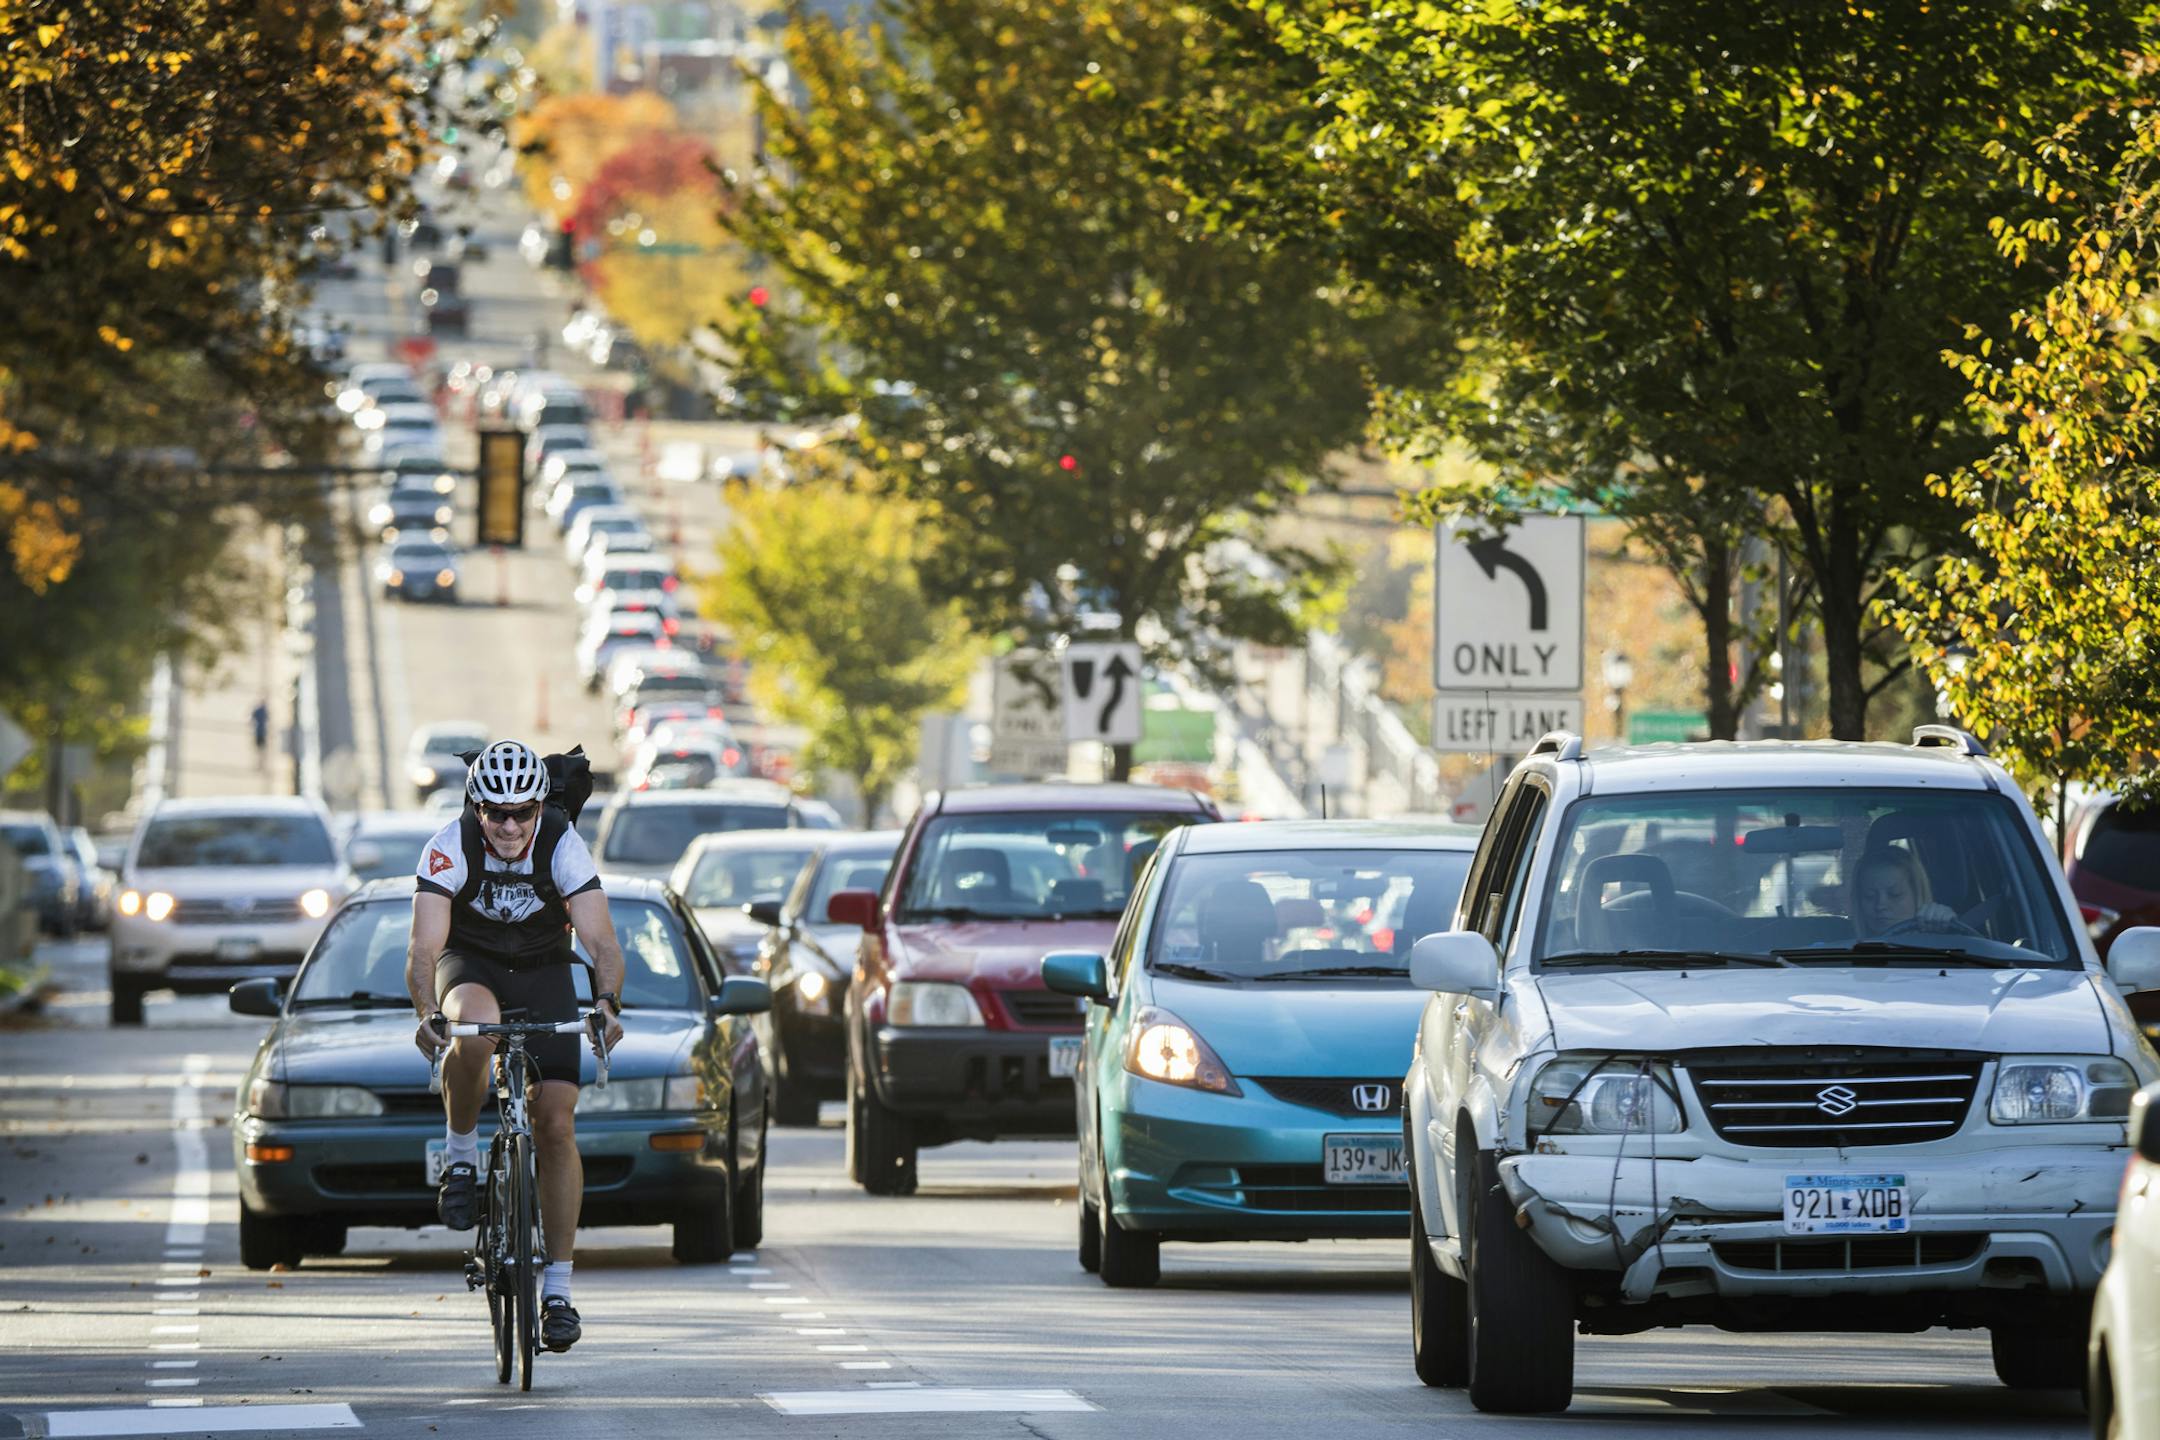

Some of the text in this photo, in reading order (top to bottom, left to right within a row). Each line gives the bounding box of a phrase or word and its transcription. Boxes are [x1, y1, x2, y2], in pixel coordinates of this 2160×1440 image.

[1453, 642, 1558, 676] ONLY
[1448, 708, 1497, 742] LEFT
[1330, 1148, 1365, 1172] 139
[1791, 1188, 1902, 1219] 921 XDB
